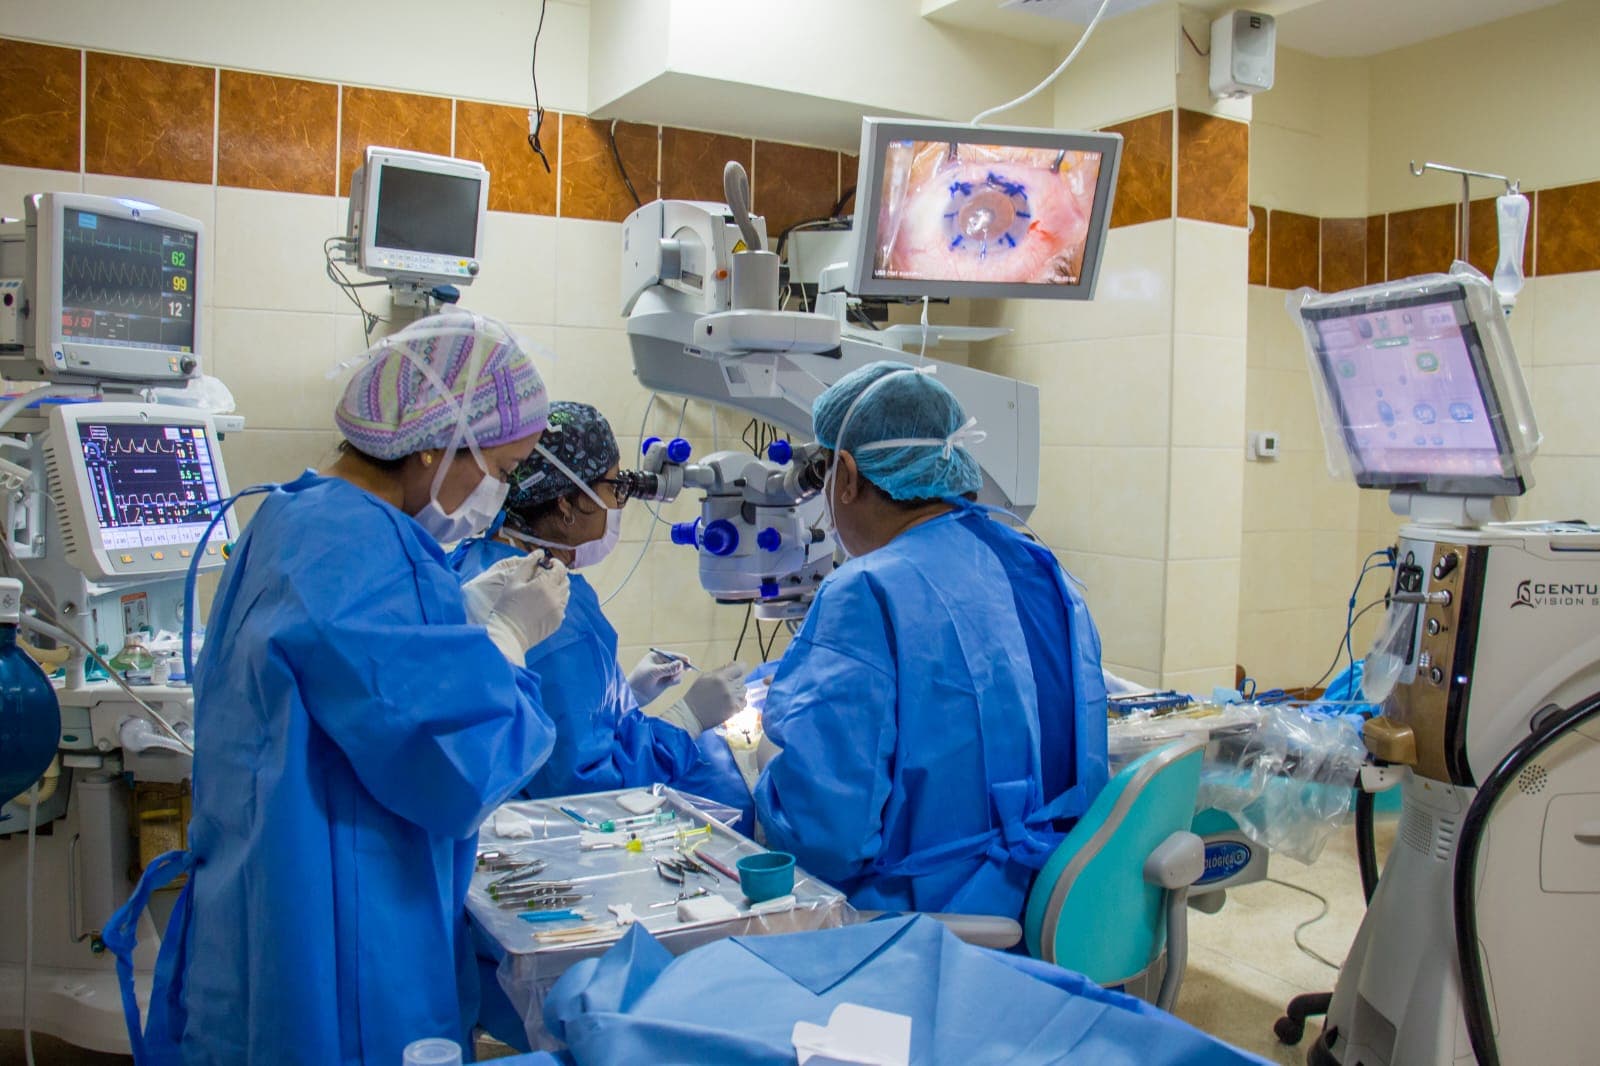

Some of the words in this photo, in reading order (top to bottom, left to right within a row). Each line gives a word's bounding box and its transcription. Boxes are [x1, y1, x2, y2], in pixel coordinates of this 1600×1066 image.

[171, 251, 186, 266] 62
[172, 276, 187, 291] 99
[168, 301, 183, 317] 12
[1534, 583, 1598, 595] CENTU
[1534, 597, 1584, 606] VISION
